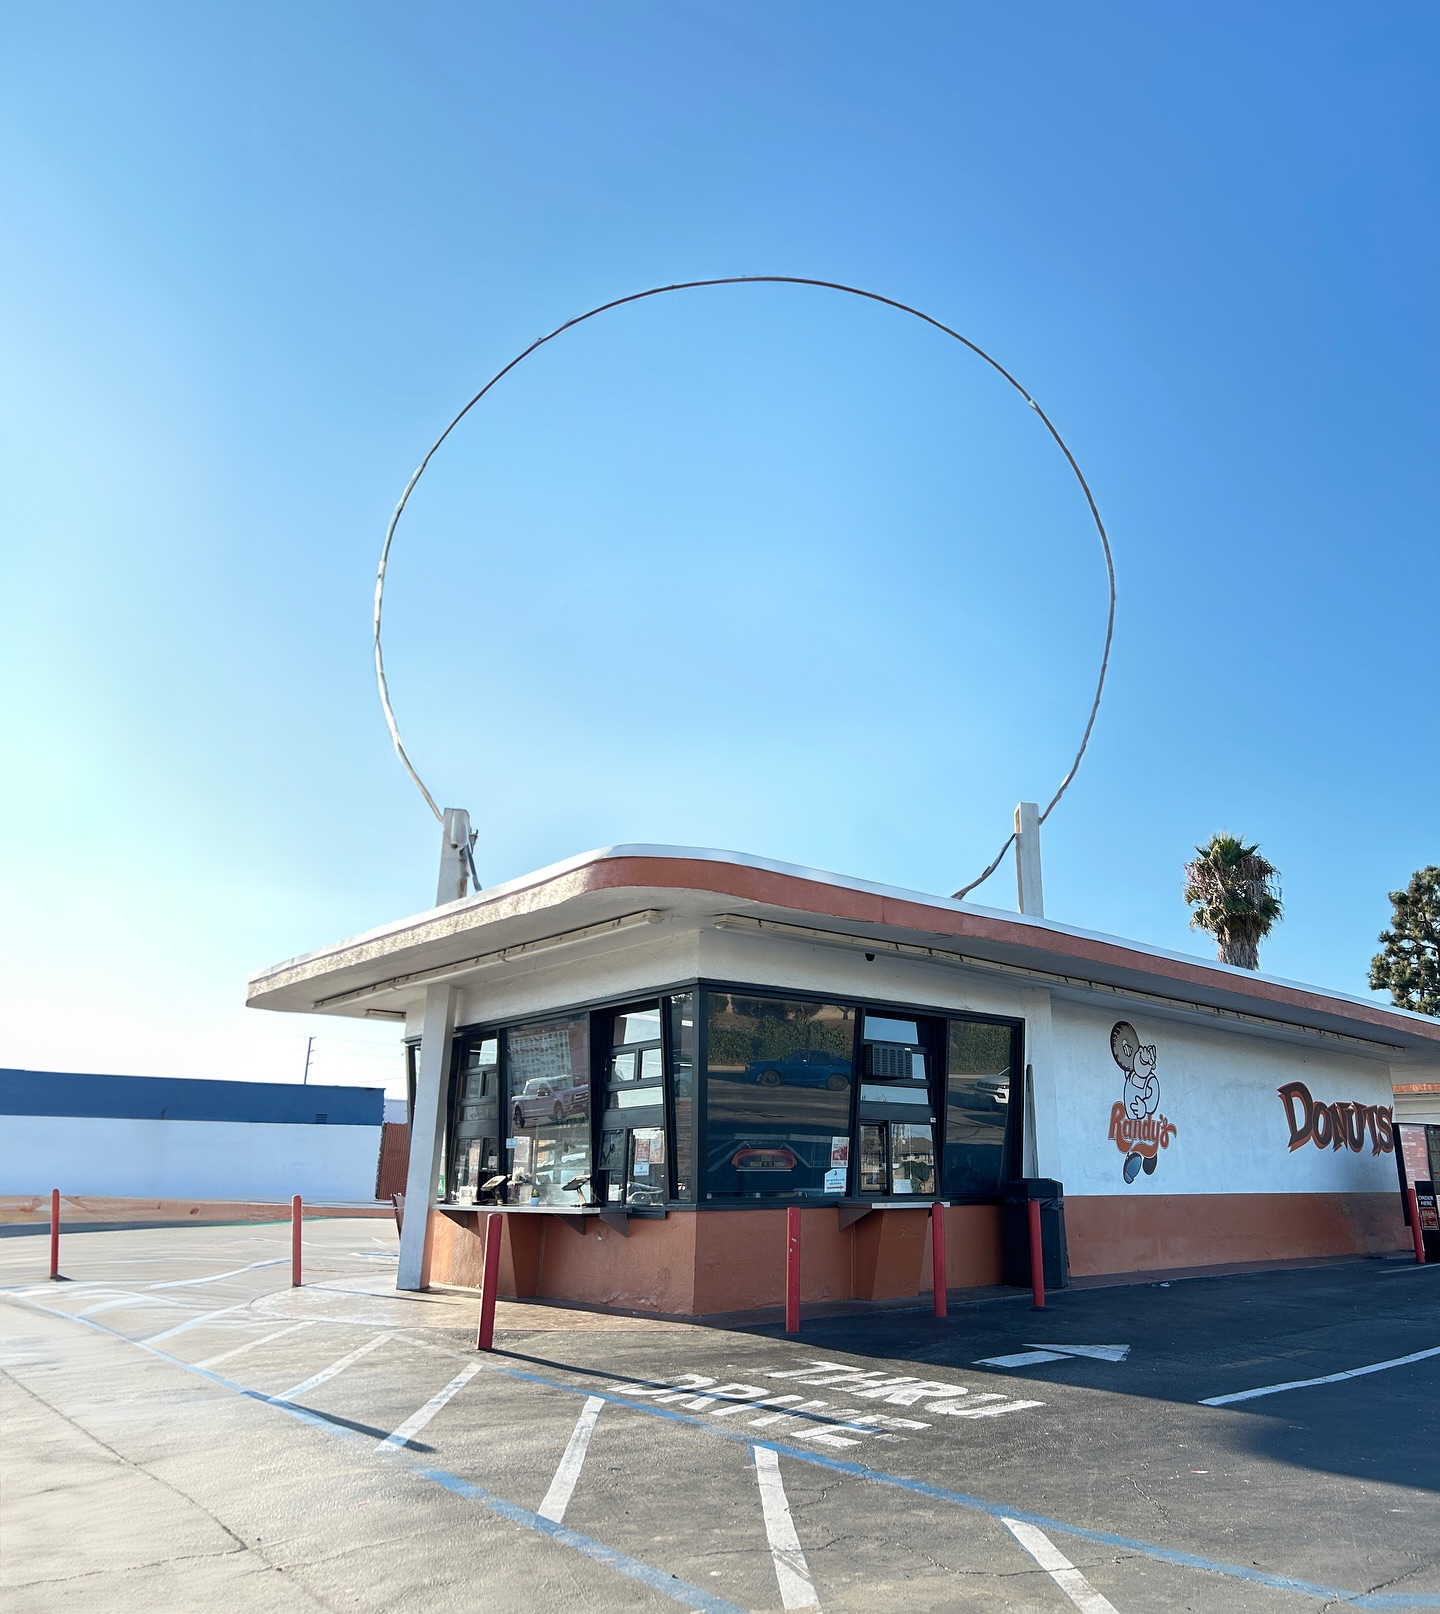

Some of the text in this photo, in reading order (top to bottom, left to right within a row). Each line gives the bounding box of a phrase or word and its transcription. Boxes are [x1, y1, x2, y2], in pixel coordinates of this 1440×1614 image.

[1108, 1101, 1177, 1158] Randy's
[1277, 1081, 1393, 1156] DONUTS
[607, 1373, 932, 1448] DRIVE
[763, 1358, 1047, 1418] THRU
